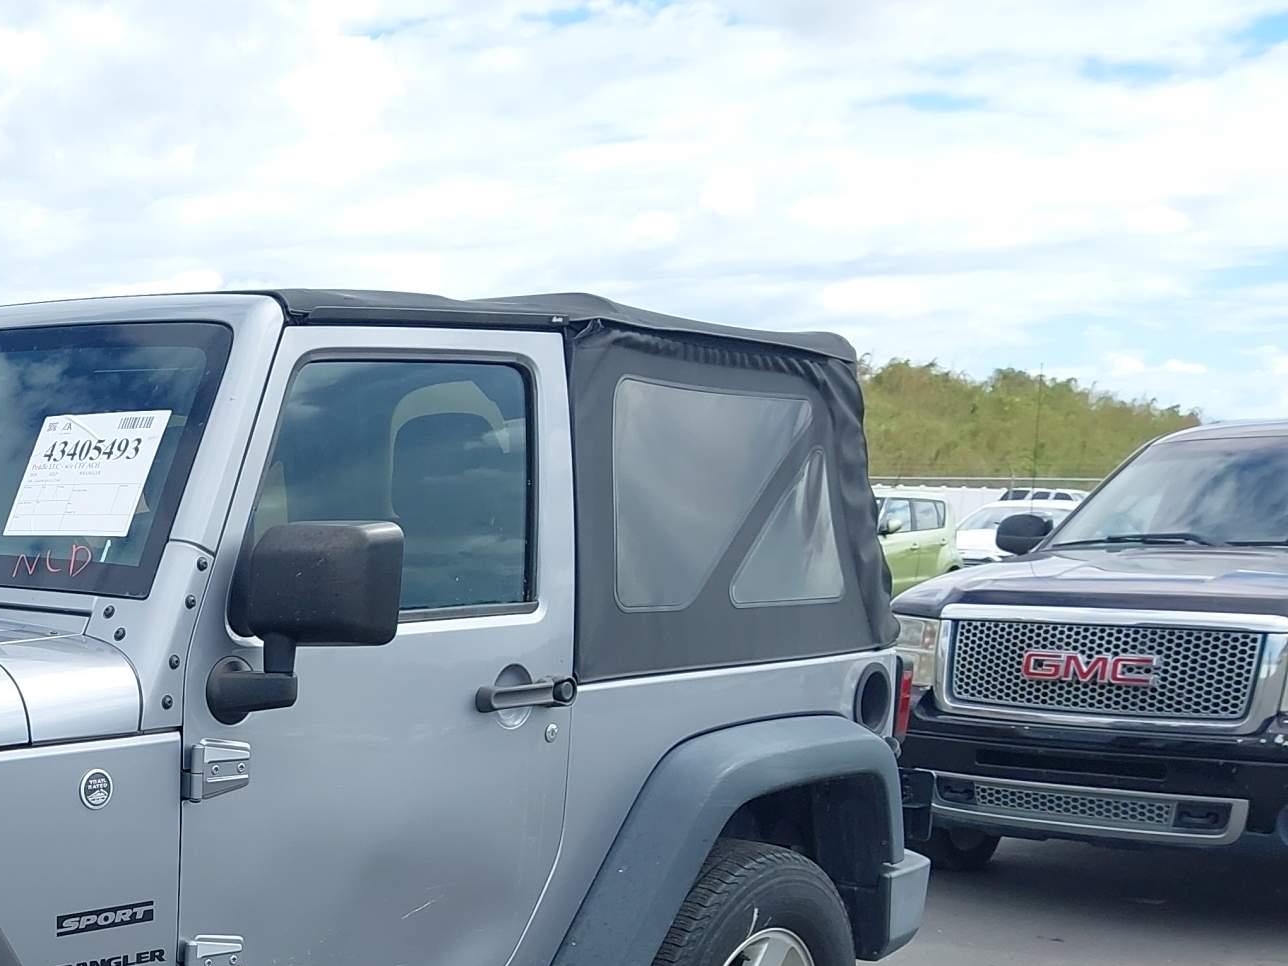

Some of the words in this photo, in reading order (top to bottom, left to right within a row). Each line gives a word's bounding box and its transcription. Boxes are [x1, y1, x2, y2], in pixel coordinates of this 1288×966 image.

[43, 437, 143, 462] 43405493
[1020, 649, 1159, 687] GMC
[59, 904, 154, 933] SPORT
